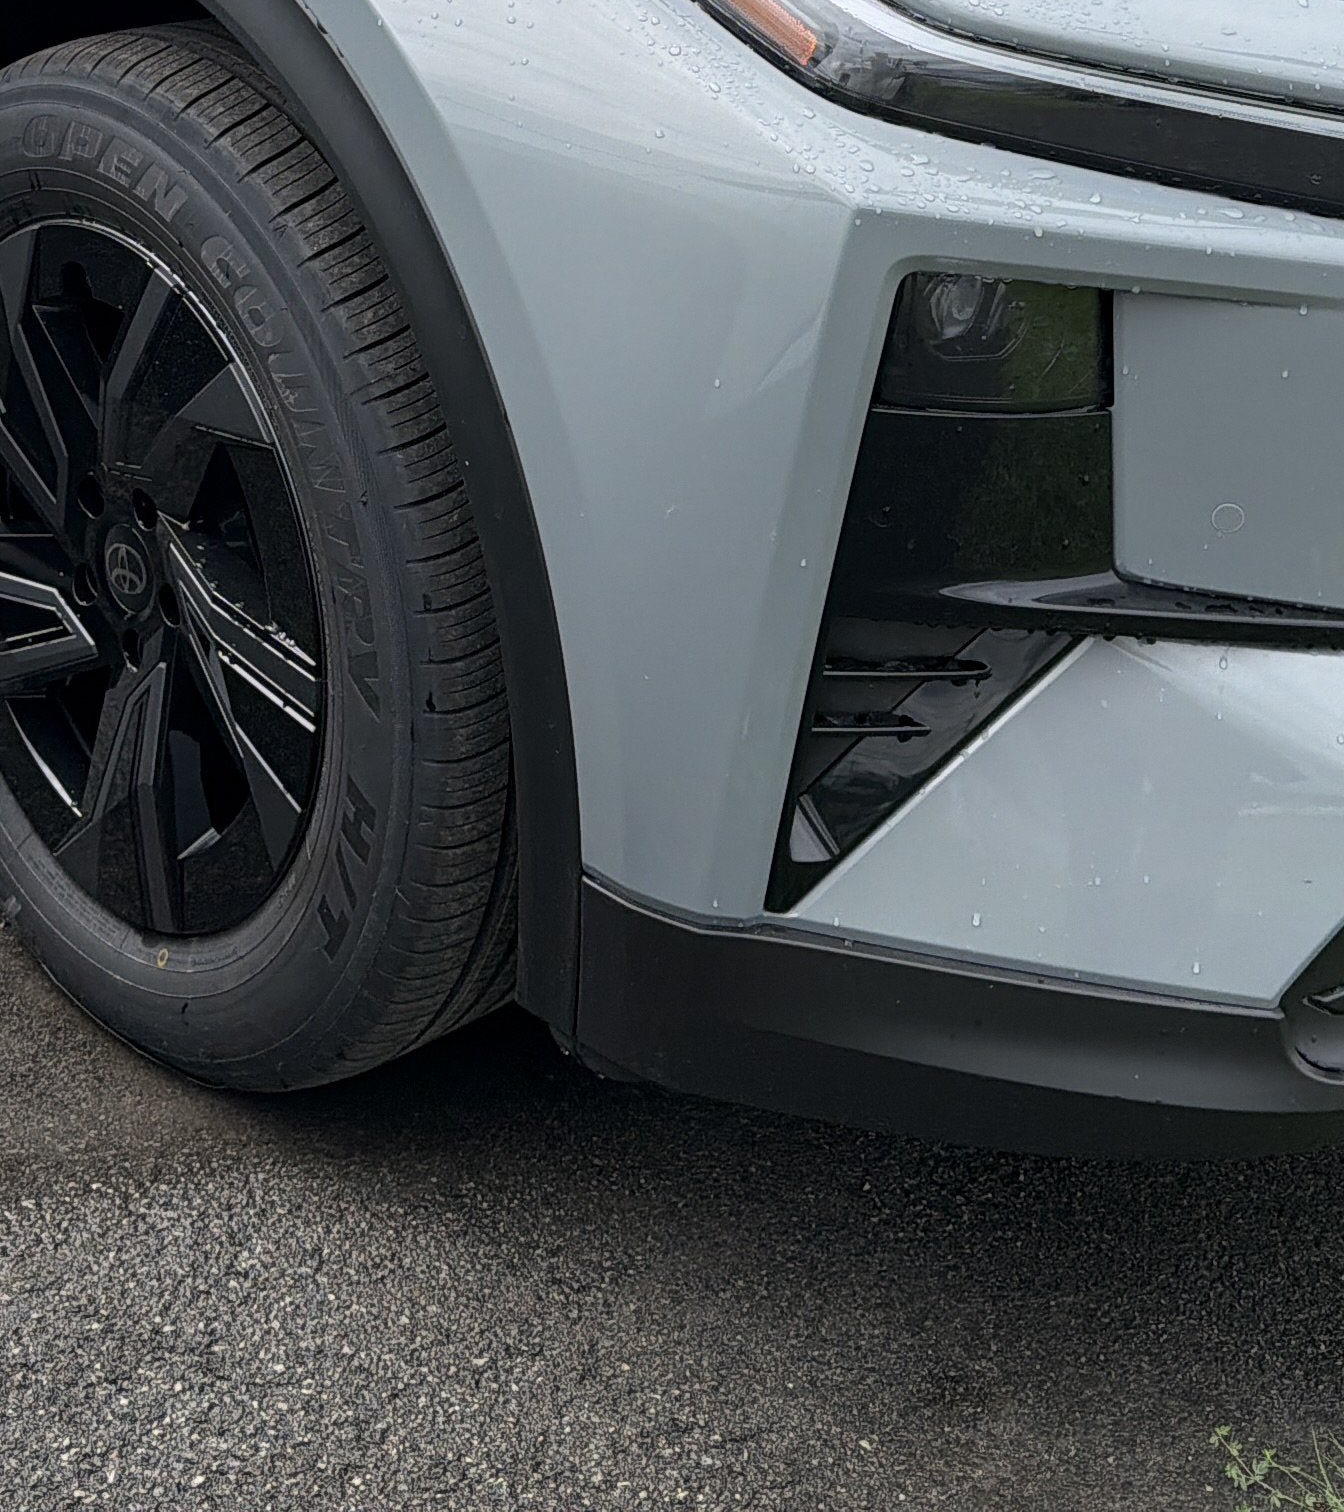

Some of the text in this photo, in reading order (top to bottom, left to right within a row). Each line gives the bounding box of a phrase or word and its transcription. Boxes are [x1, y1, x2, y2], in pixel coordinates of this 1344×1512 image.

[22, 113, 384, 964] OPEN COUNTRY H/T
